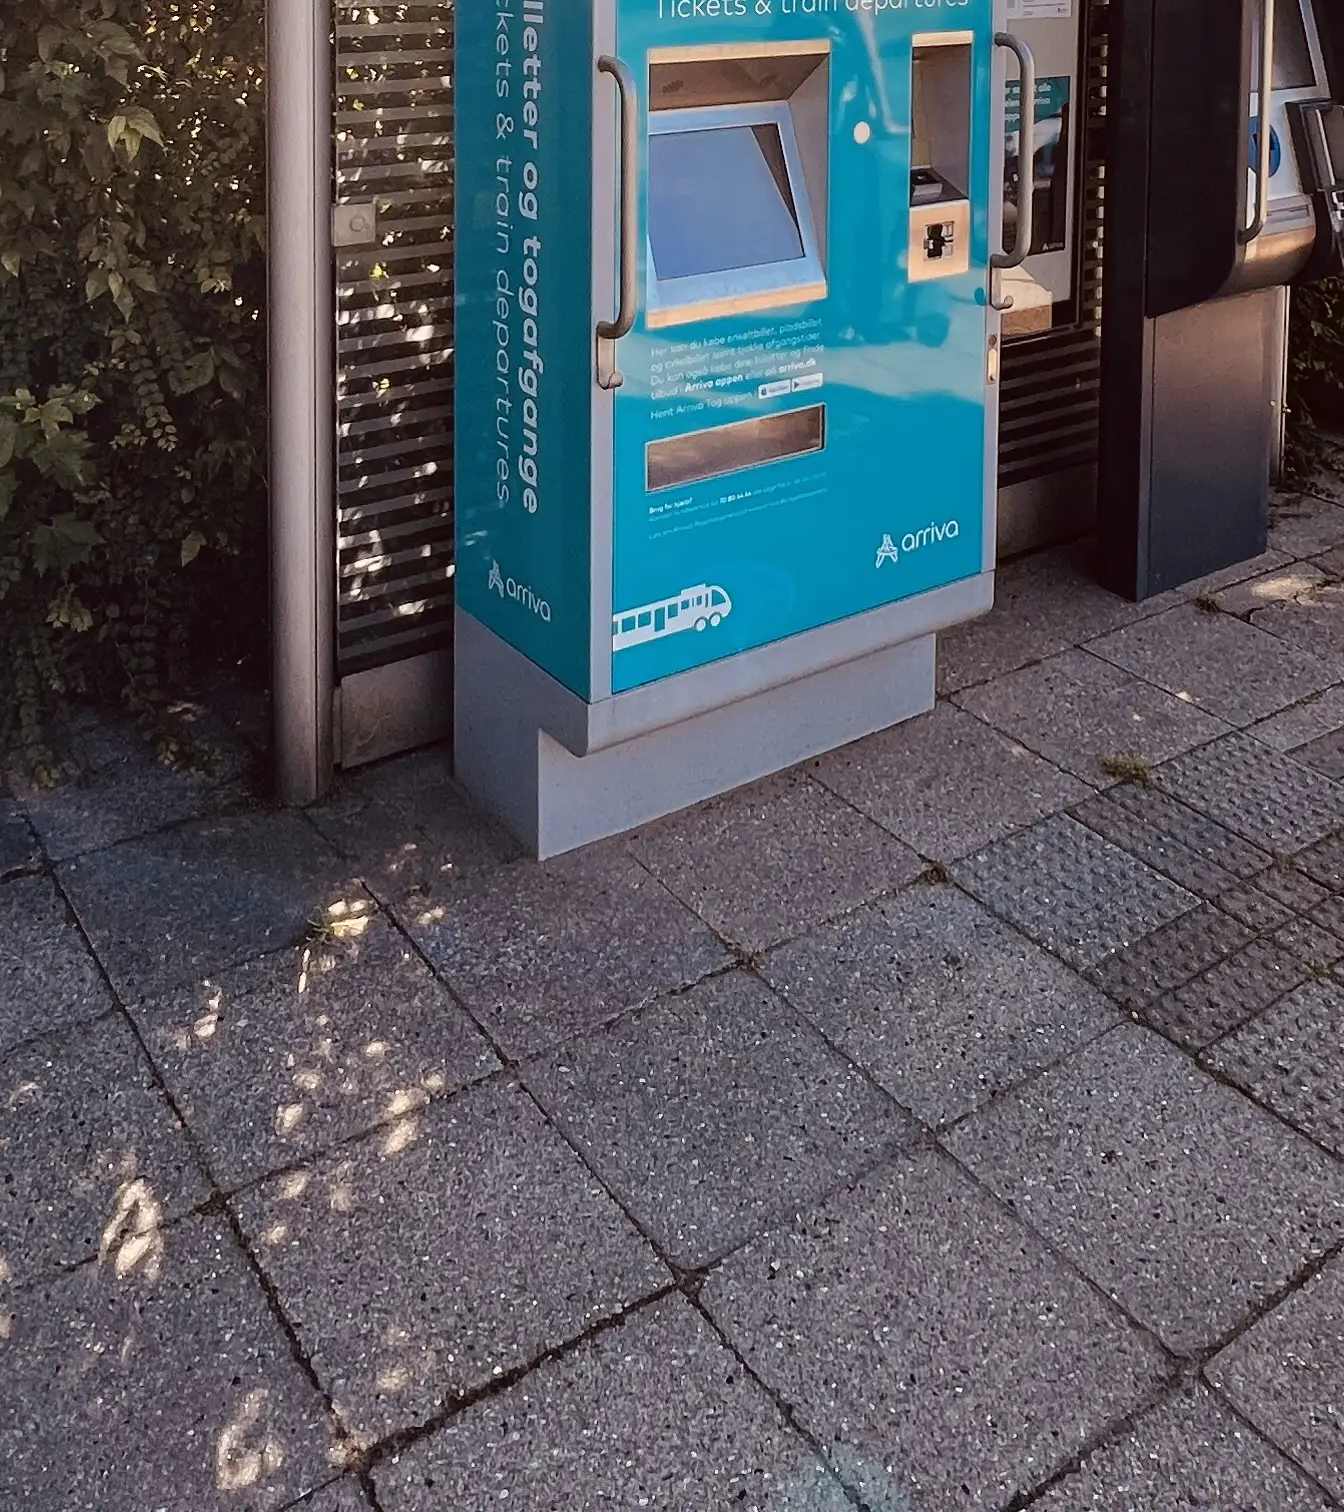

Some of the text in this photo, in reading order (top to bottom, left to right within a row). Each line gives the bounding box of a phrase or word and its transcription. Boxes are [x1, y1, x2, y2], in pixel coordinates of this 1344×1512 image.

[496, 113, 514, 140] &
[496, 155, 514, 254] train
[519, 161, 538, 220] og
[493, 269, 515, 503] departures
[519, 236, 543, 514] togafgange
[685, 378, 714, 393] Arriva
[715, 373, 744, 388] appen
[902, 521, 959, 552] arriva
[506, 577, 551, 623] arriva
